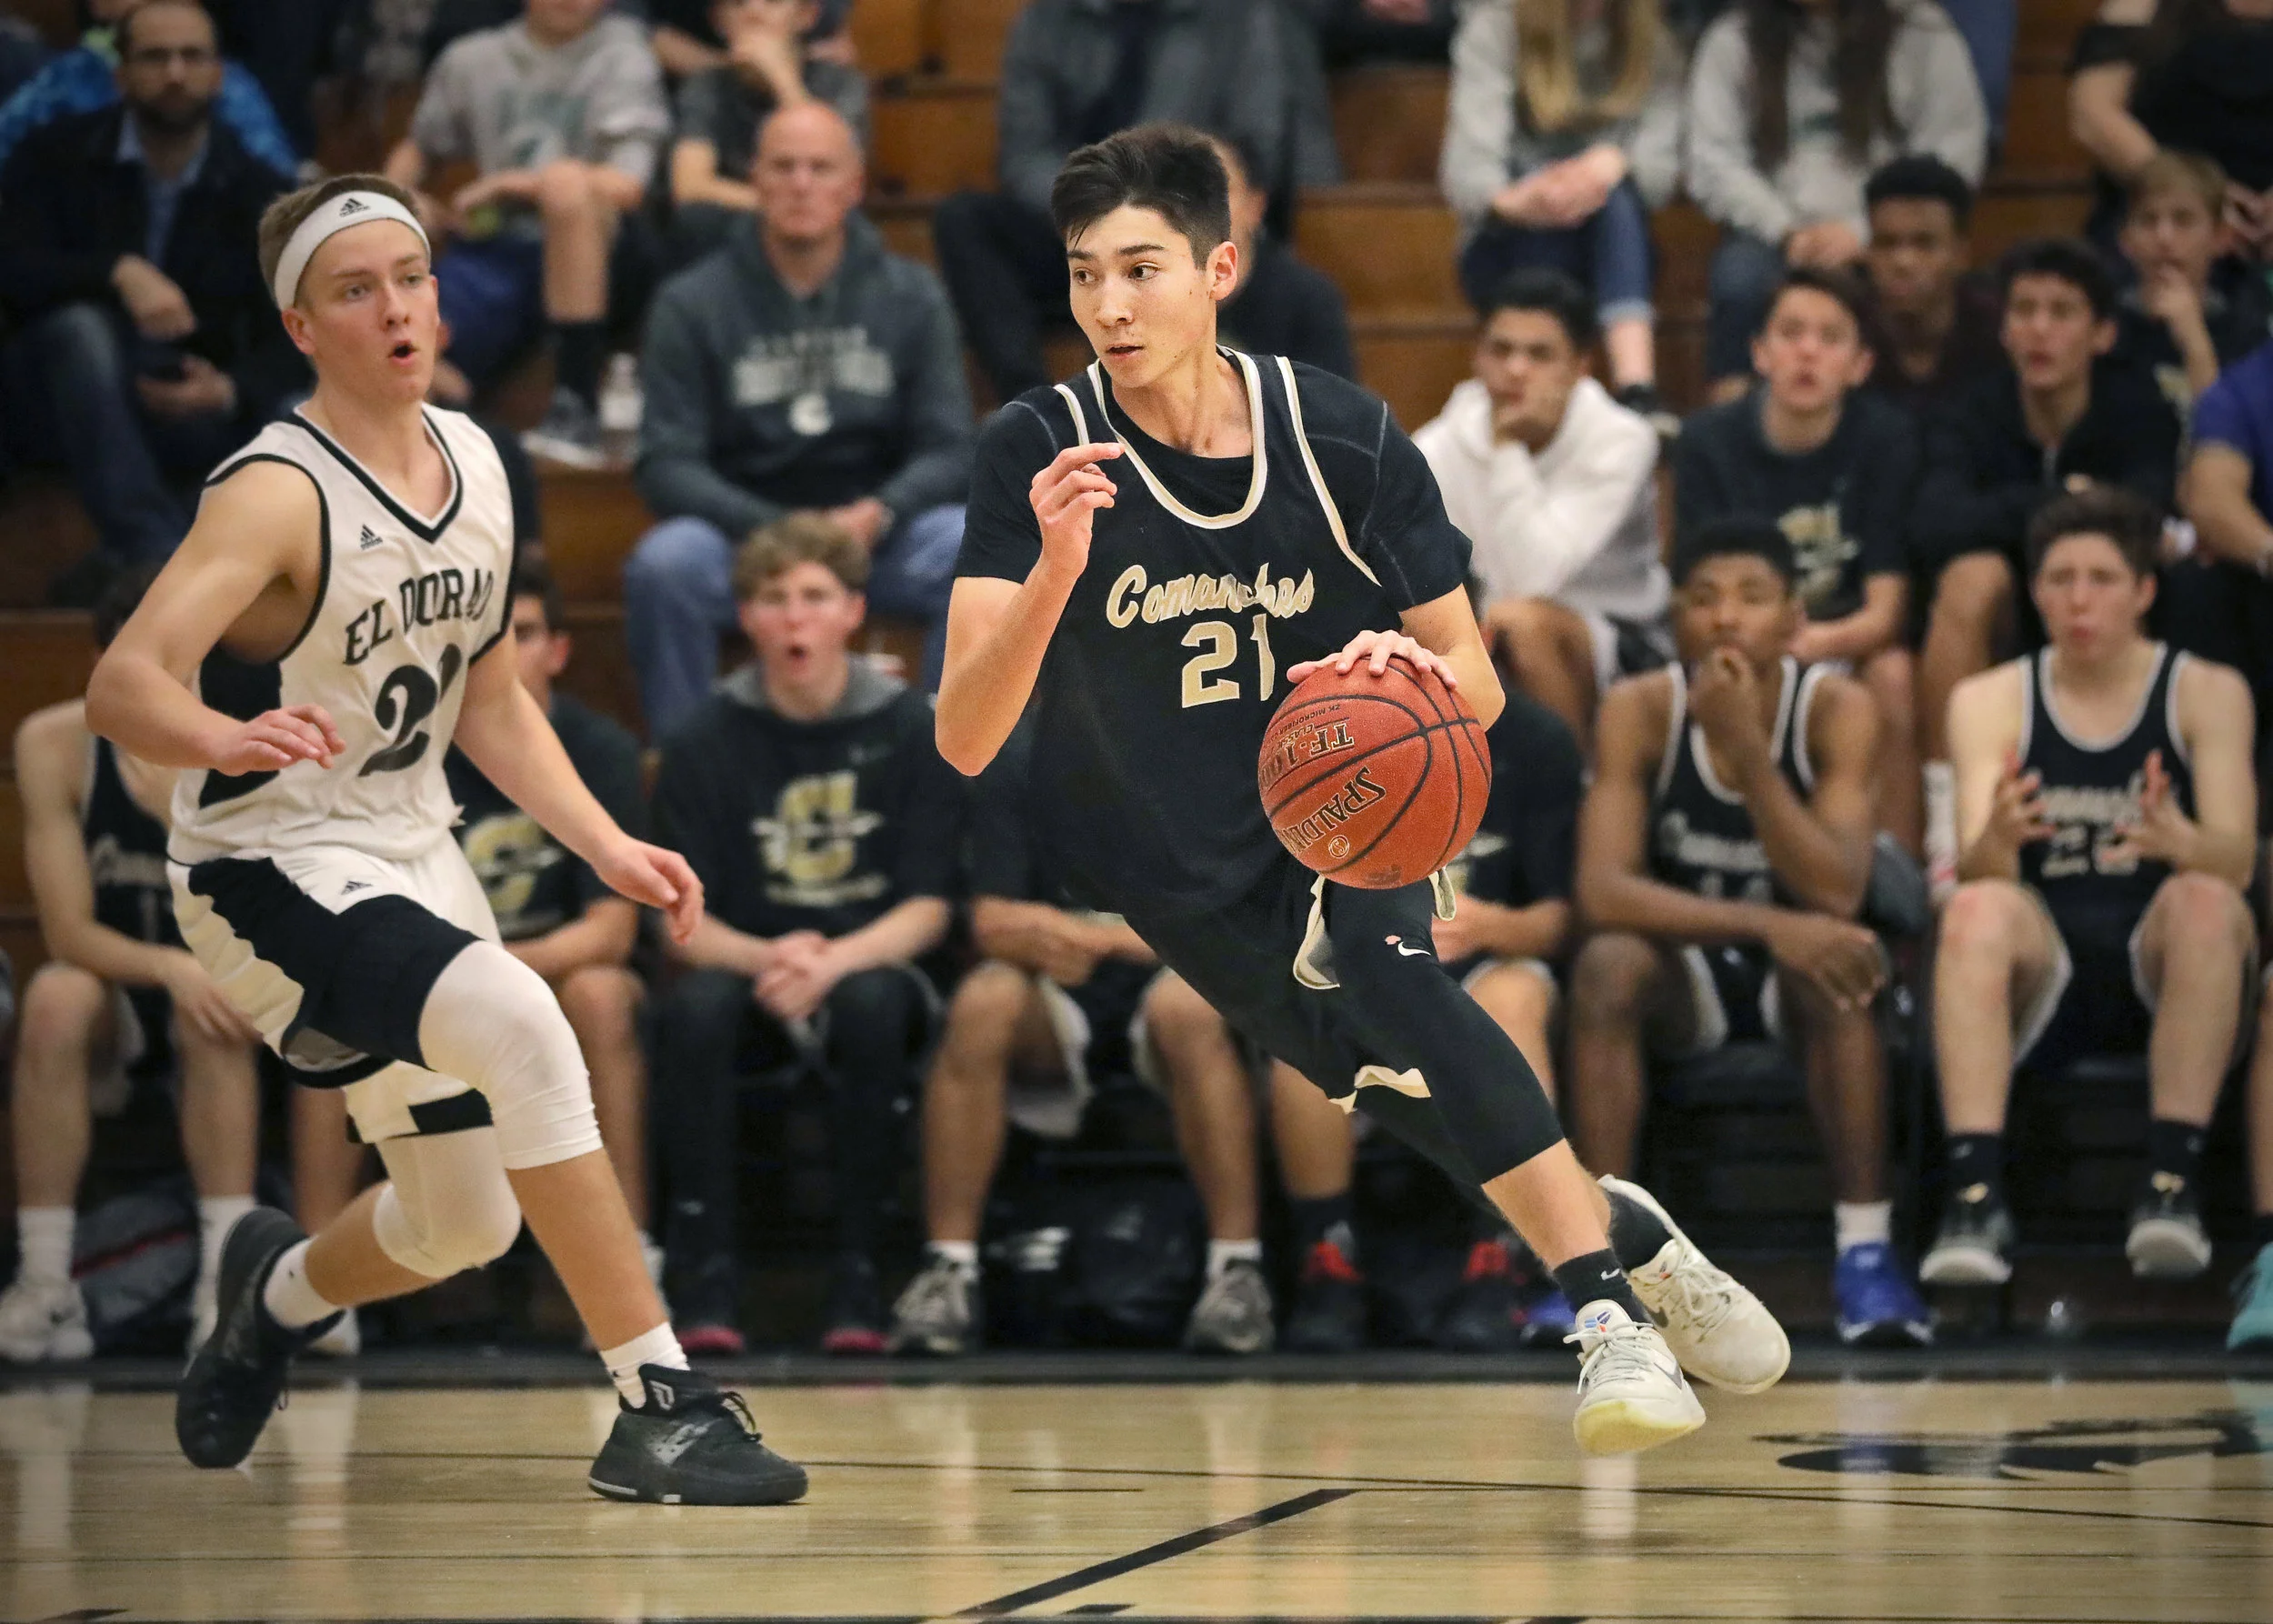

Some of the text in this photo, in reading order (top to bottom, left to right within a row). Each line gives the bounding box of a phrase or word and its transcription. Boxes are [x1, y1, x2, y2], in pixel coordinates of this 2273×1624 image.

[342, 596, 394, 667] EL
[1106, 562, 1316, 629] Comanches
[1180, 612, 1277, 709] 21
[1276, 766, 1387, 857] SPALDIN
